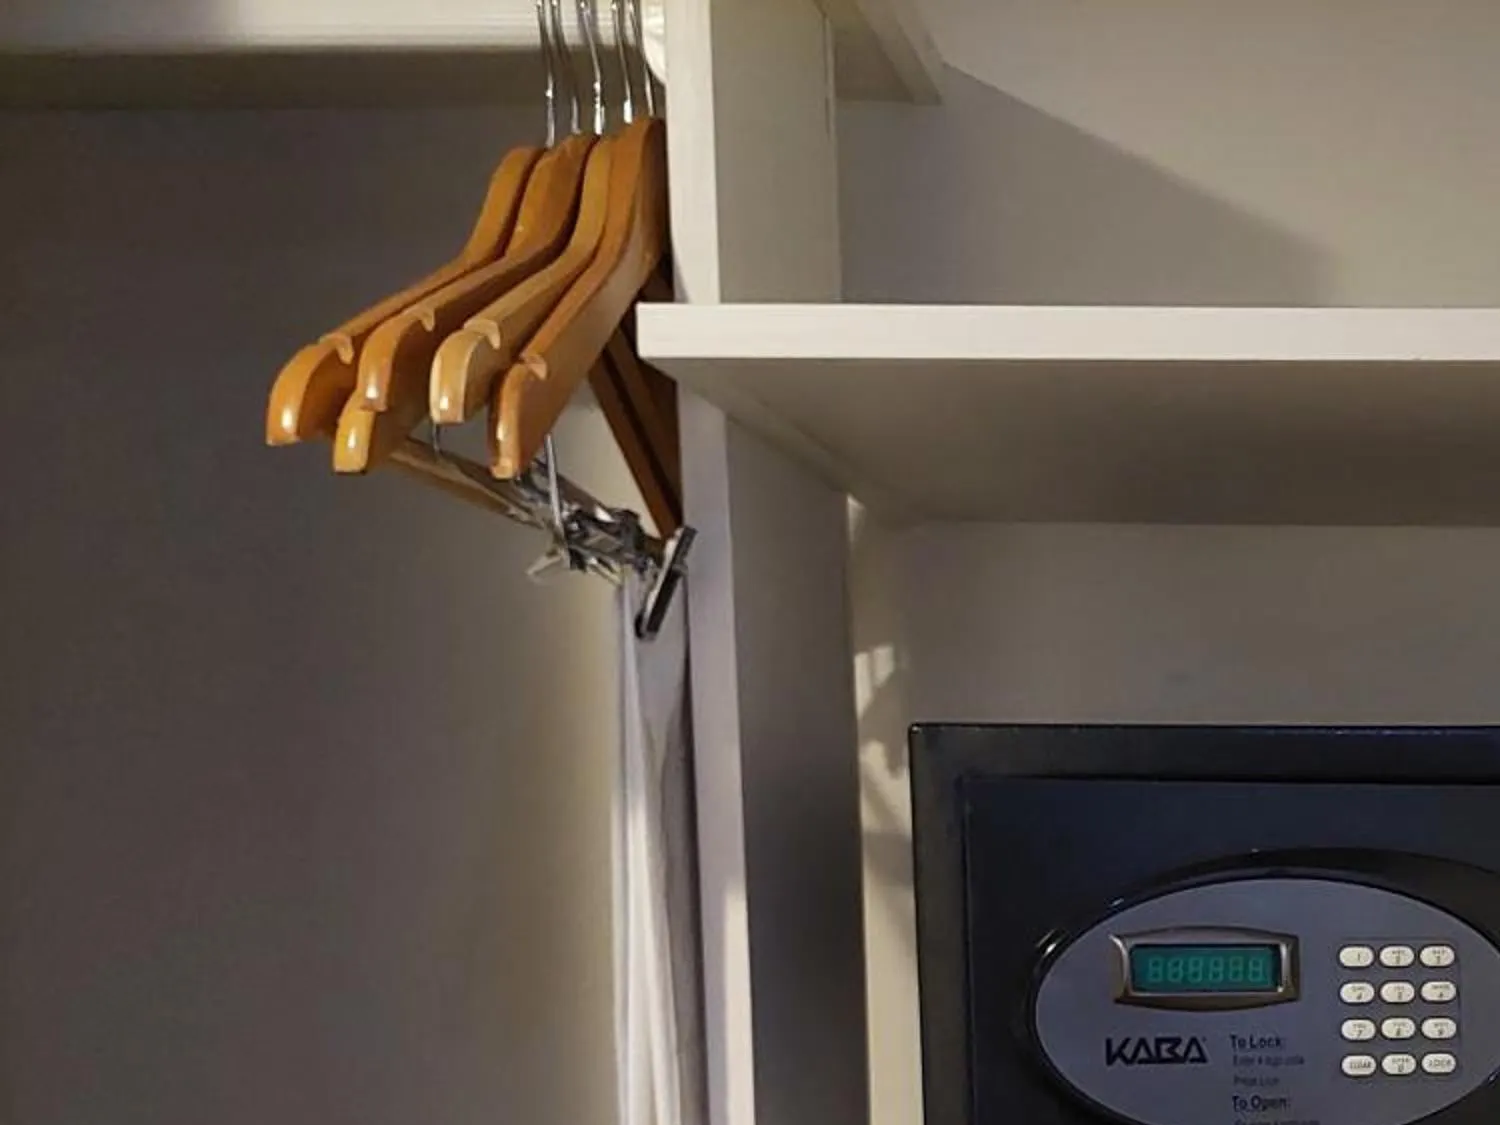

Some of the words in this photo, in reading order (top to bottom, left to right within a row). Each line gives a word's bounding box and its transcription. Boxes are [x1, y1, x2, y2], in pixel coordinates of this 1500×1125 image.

[1230, 1034, 1247, 1049] To
[1105, 1036, 1208, 1066] KABA
[1232, 1095, 1248, 1111] To
